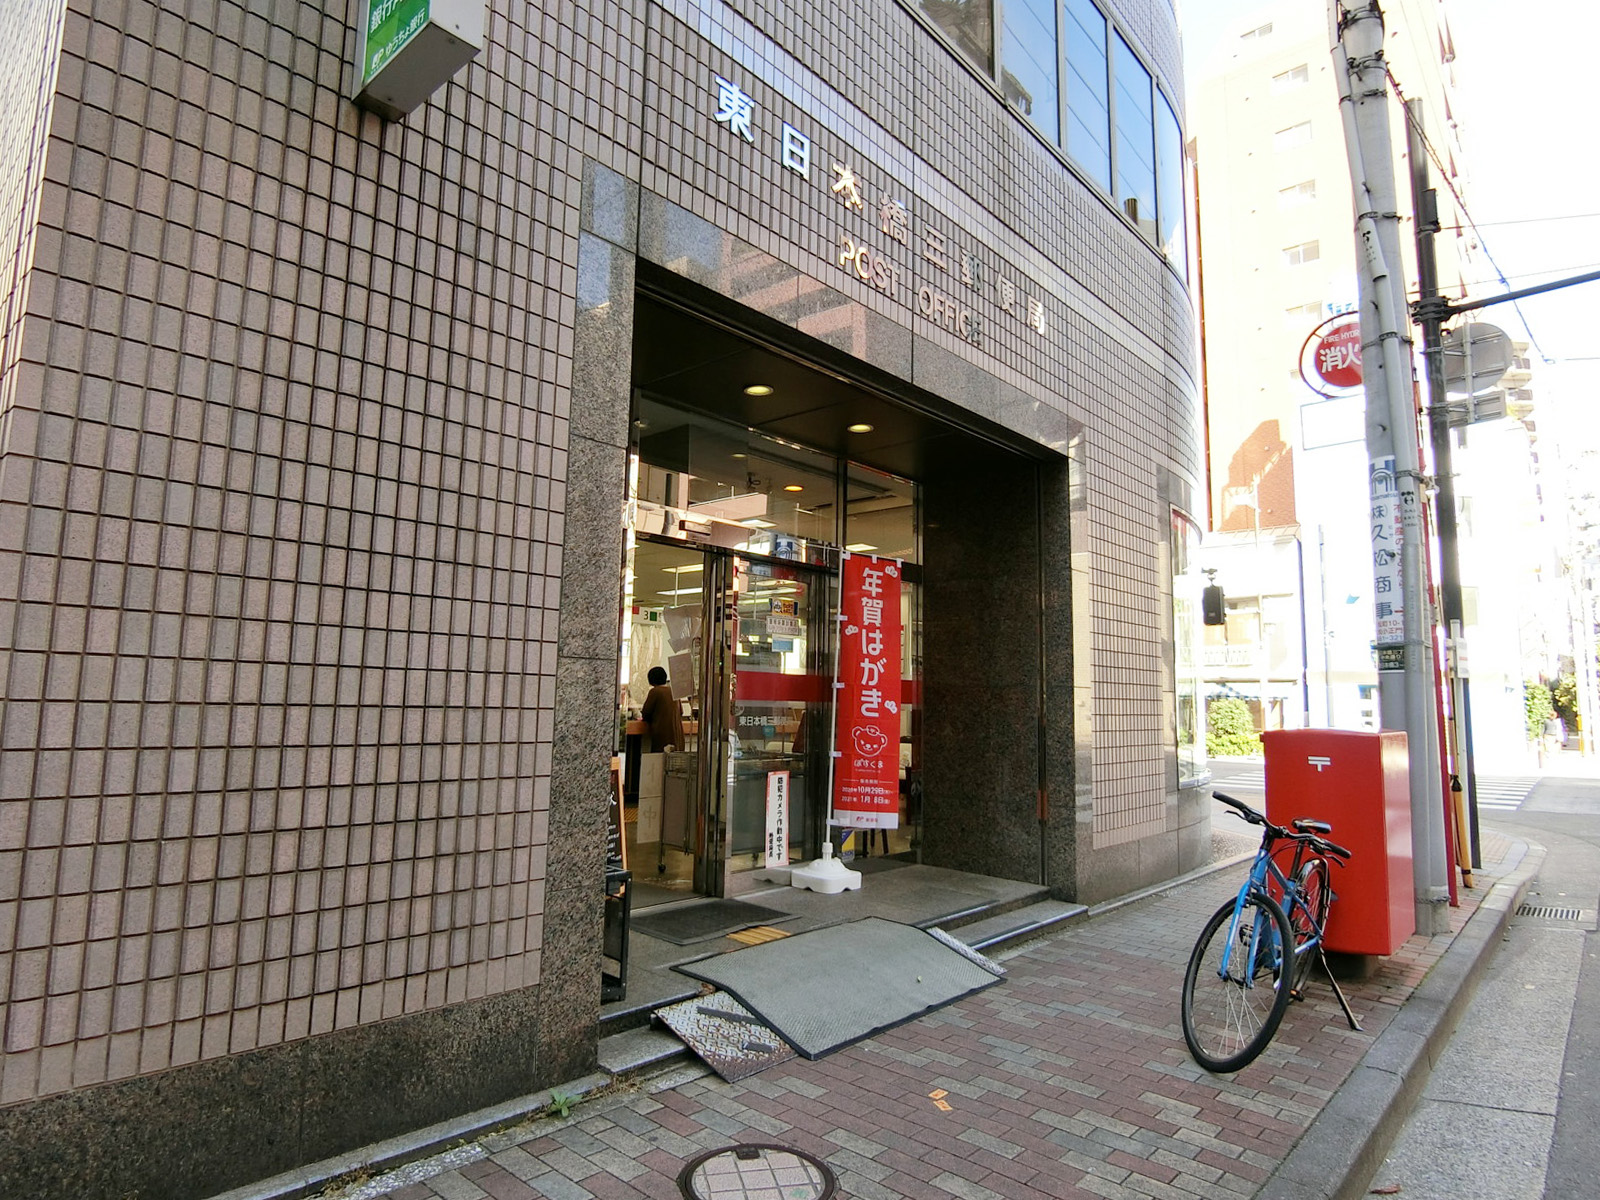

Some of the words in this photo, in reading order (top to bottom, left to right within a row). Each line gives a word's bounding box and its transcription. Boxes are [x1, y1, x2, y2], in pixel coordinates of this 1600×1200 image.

[385, 8, 425, 57] ゆうちょ銀行
[713, 74, 1046, 335] 東日本橋三郵便局
[839, 234, 901, 297] POST
[917, 285, 984, 347] OFFICE
[1319, 343, 1362, 374] 消火
[1323, 334, 1340, 345] FIRE
[1340, 329, 1360, 340] HYDR
[860, 567, 887, 718] 年賀はがき
